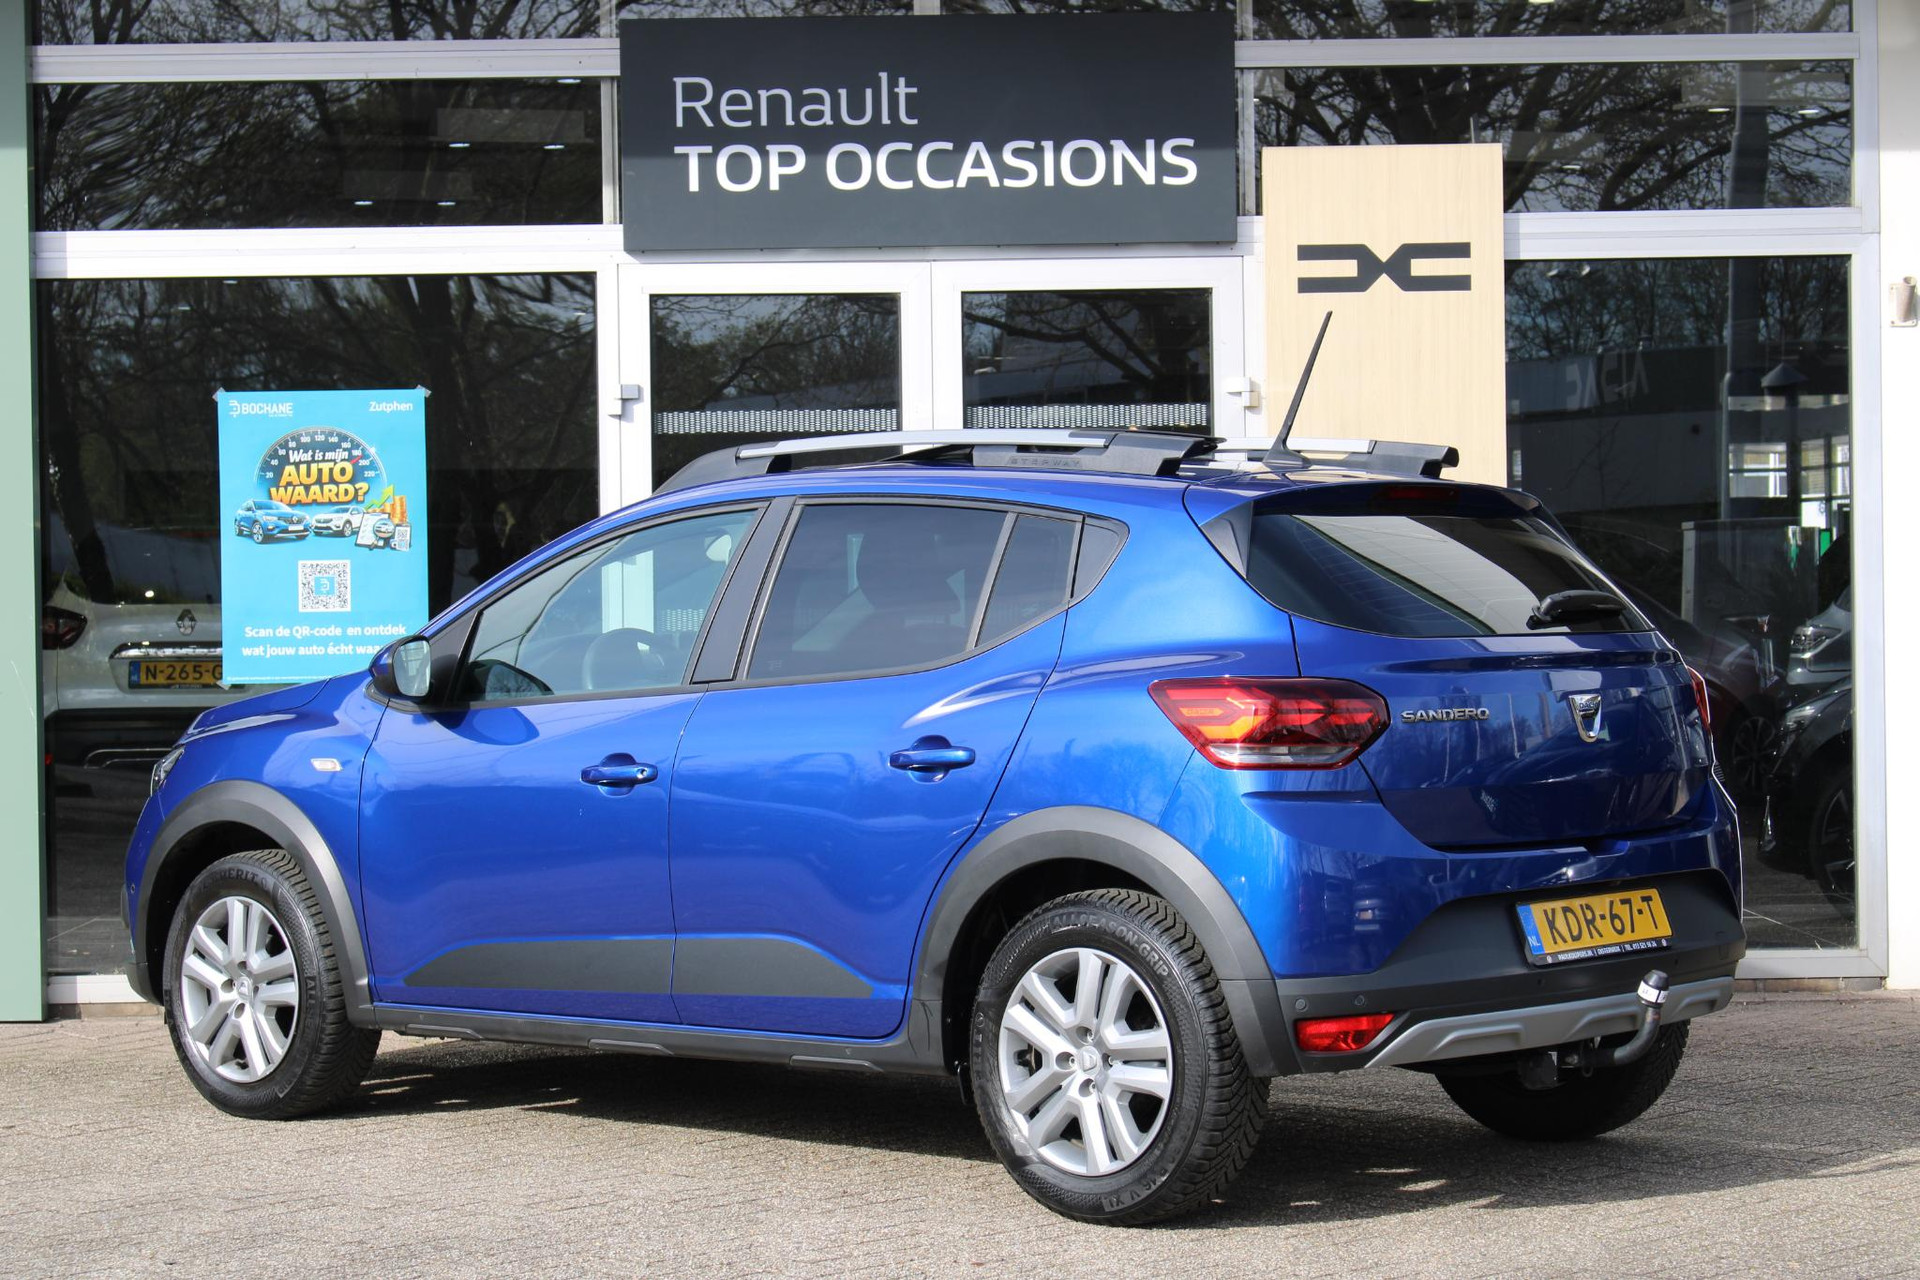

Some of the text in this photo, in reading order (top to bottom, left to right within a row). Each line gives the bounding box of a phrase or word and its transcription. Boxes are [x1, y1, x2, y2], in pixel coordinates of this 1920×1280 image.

[672, 71, 919, 128] Renault
[674, 137, 1198, 192] TOP OCCASIONS
[241, 403, 294, 414] BOCHANE
[369, 401, 413, 413] Zutphen
[289, 449, 349, 463] Wat is mijn
[280, 462, 353, 486] AUTO
[270, 483, 368, 504] WAARD?
[244, 623, 407, 639] Scan de QR-code en ontdek
[242, 642, 383, 658] wat jouw auto écht waa
[1401, 707, 1490, 723] SANDERO
[1542, 895, 1658, 946] KDR-67-T
[1528, 935, 1541, 947] NL
